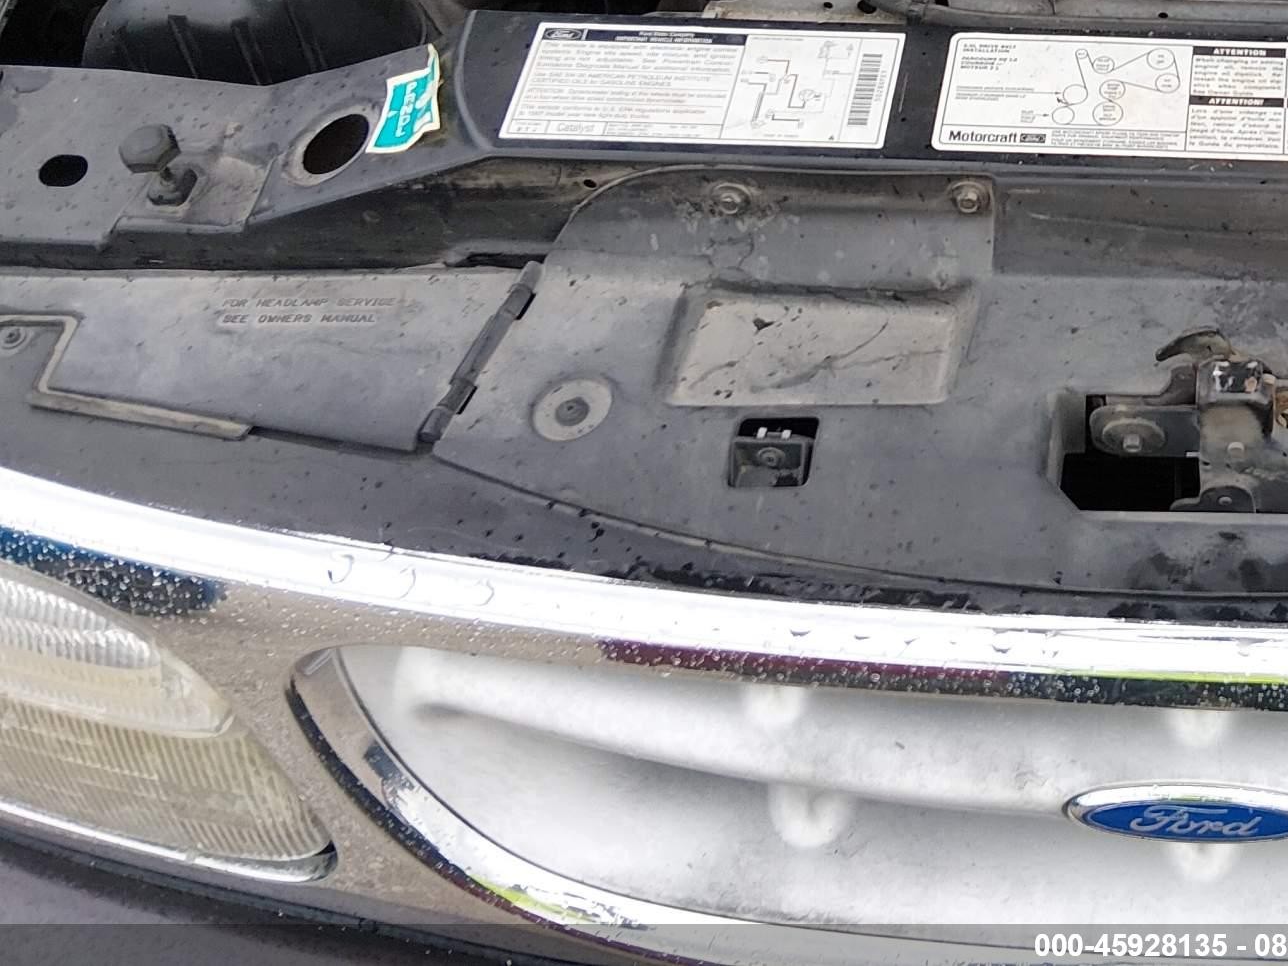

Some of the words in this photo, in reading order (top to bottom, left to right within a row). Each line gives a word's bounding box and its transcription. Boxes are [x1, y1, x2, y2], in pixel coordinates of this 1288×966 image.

[556, 122, 594, 133] Catalyst
[948, 130, 1020, 144] Motorcraft
[222, 298, 248, 307] FOR
[256, 298, 328, 307] HEADLAMP
[336, 298, 397, 306] SERVICE
[222, 314, 249, 323] SEE
[258, 314, 313, 323] OWNERS
[320, 314, 376, 323] MANUAL
[1130, 804, 1262, 835] Ford
